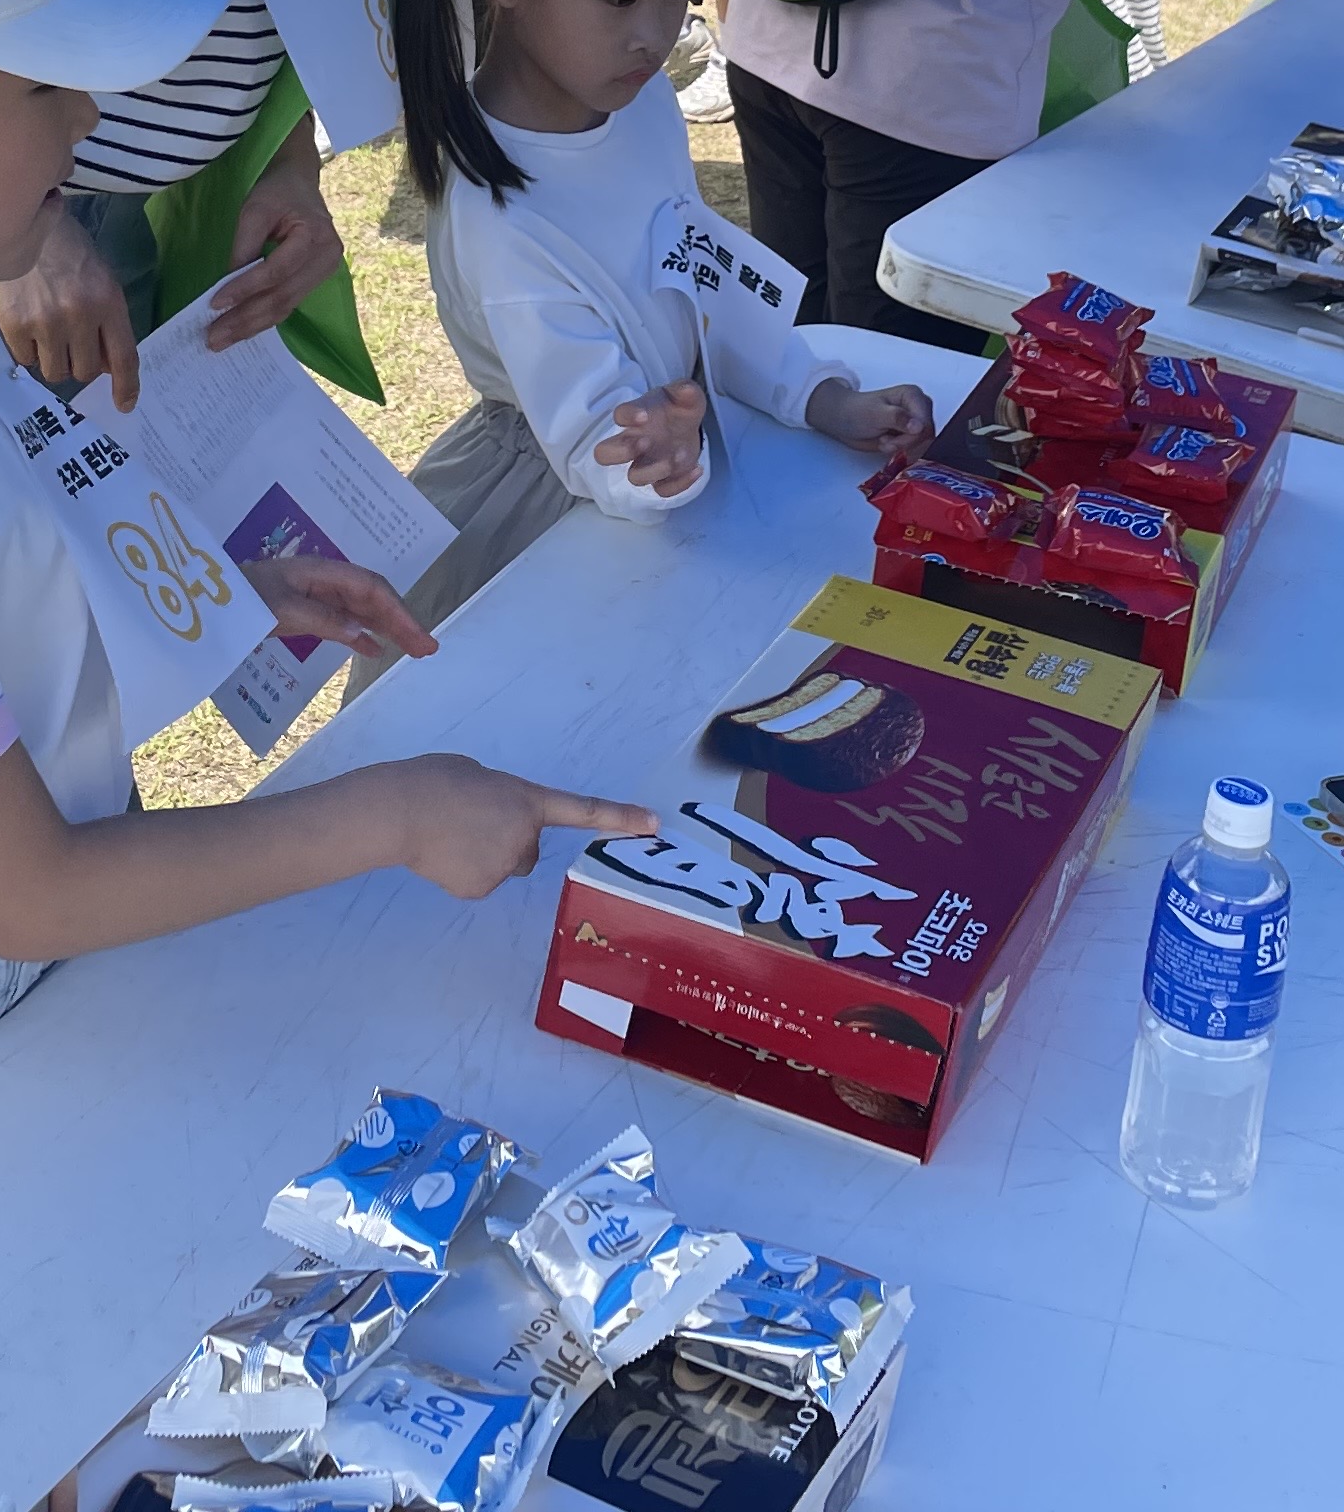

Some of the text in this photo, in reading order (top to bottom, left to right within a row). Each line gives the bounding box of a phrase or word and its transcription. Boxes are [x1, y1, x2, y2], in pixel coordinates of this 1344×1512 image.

[79, 433, 131, 480] 런닝
[1074, 500, 1162, 541] 오예스
[105, 490, 232, 644] 84
[892, 888, 975, 977] 초코파이
[1167, 887, 1245, 931] 포카리 스웨트
[951, 920, 989, 964] 오리온
[492, 1307, 560, 1374] IGINAL
